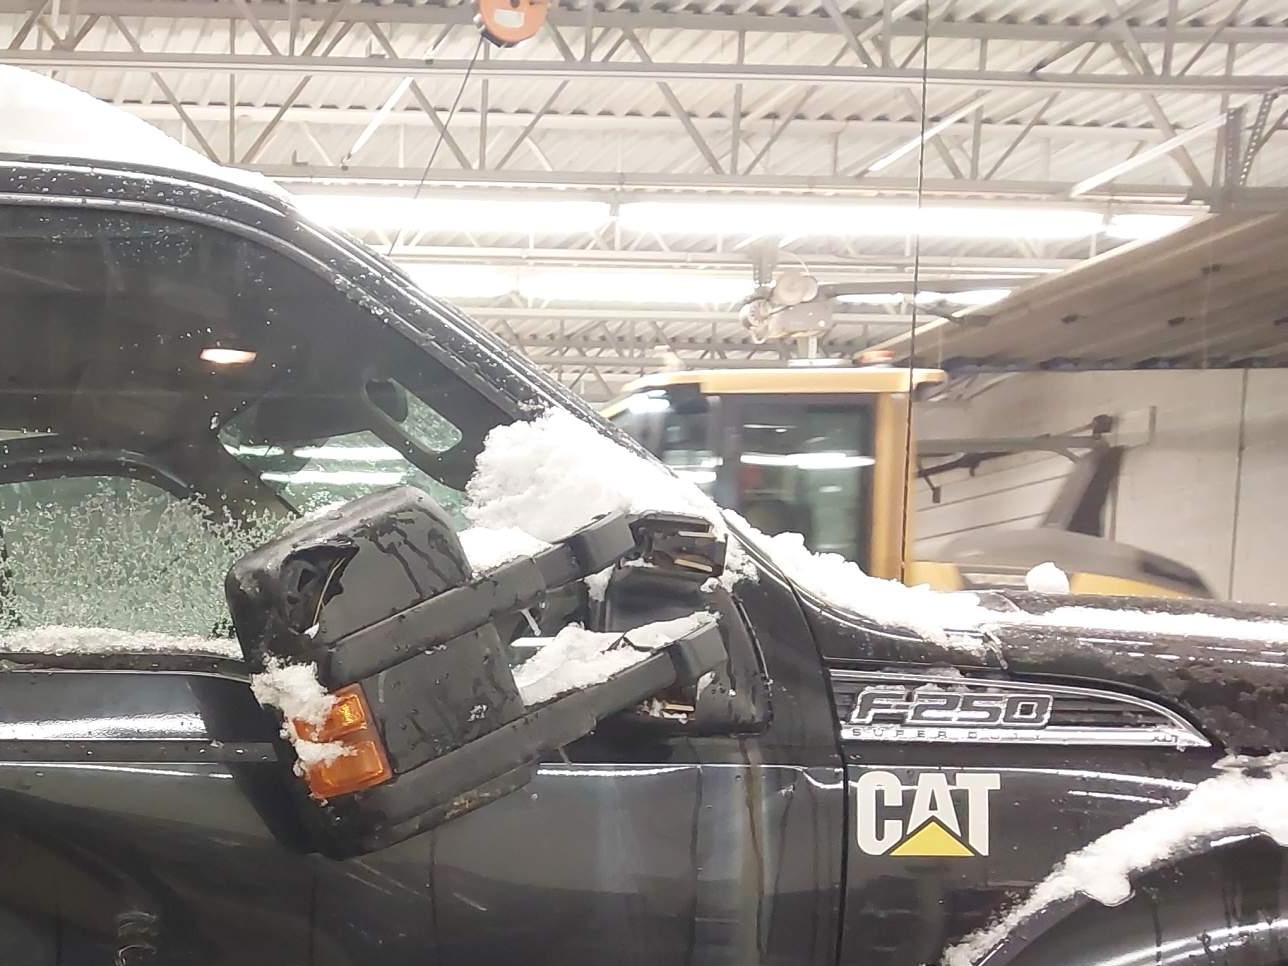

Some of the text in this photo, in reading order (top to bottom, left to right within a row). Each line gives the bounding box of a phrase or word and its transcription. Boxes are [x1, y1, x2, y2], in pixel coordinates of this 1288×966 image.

[850, 689, 1054, 727] F-250
[851, 728, 948, 739] SUPER
[856, 770, 1001, 857] CAT
